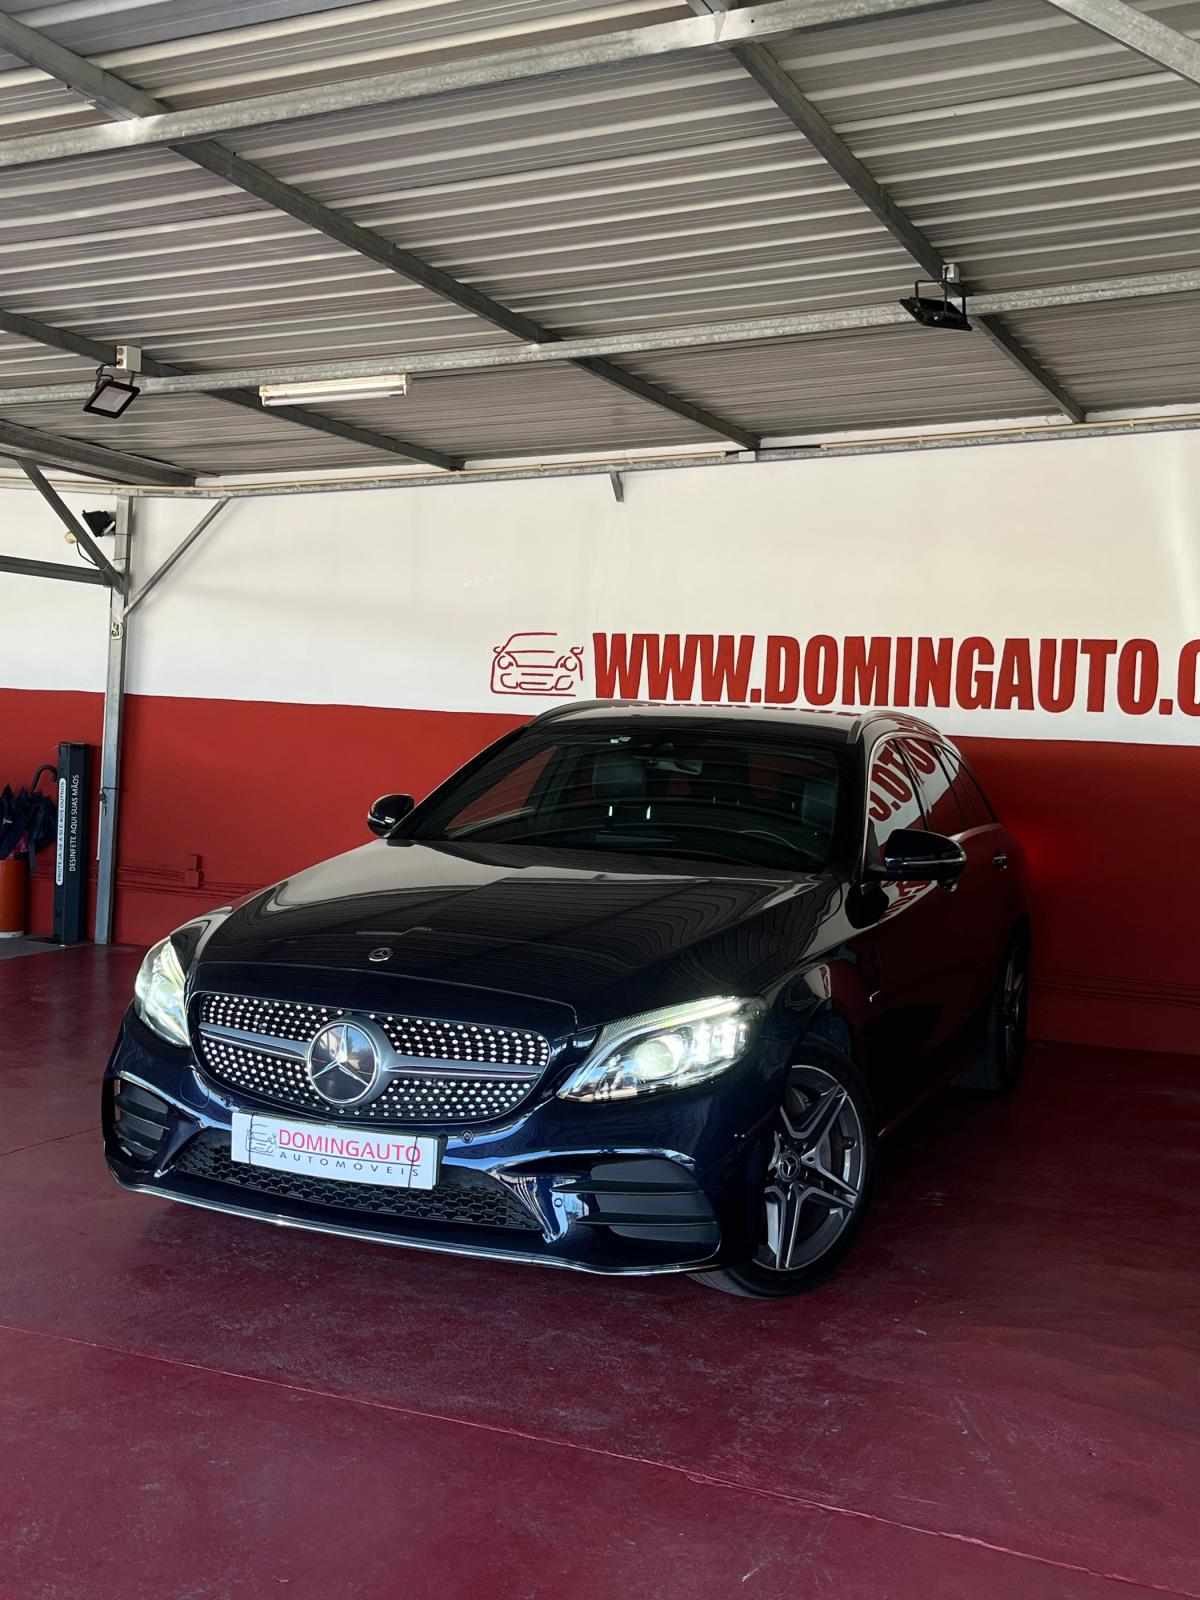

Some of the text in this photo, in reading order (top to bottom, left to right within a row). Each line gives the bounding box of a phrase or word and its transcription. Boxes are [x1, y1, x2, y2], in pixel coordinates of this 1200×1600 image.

[71, 774, 80, 796] MÃOS
[70, 816, 78, 835] AQUI
[69, 836, 77, 872] DESINFETE
[278, 1128, 421, 1163] DOMINGAUTO
